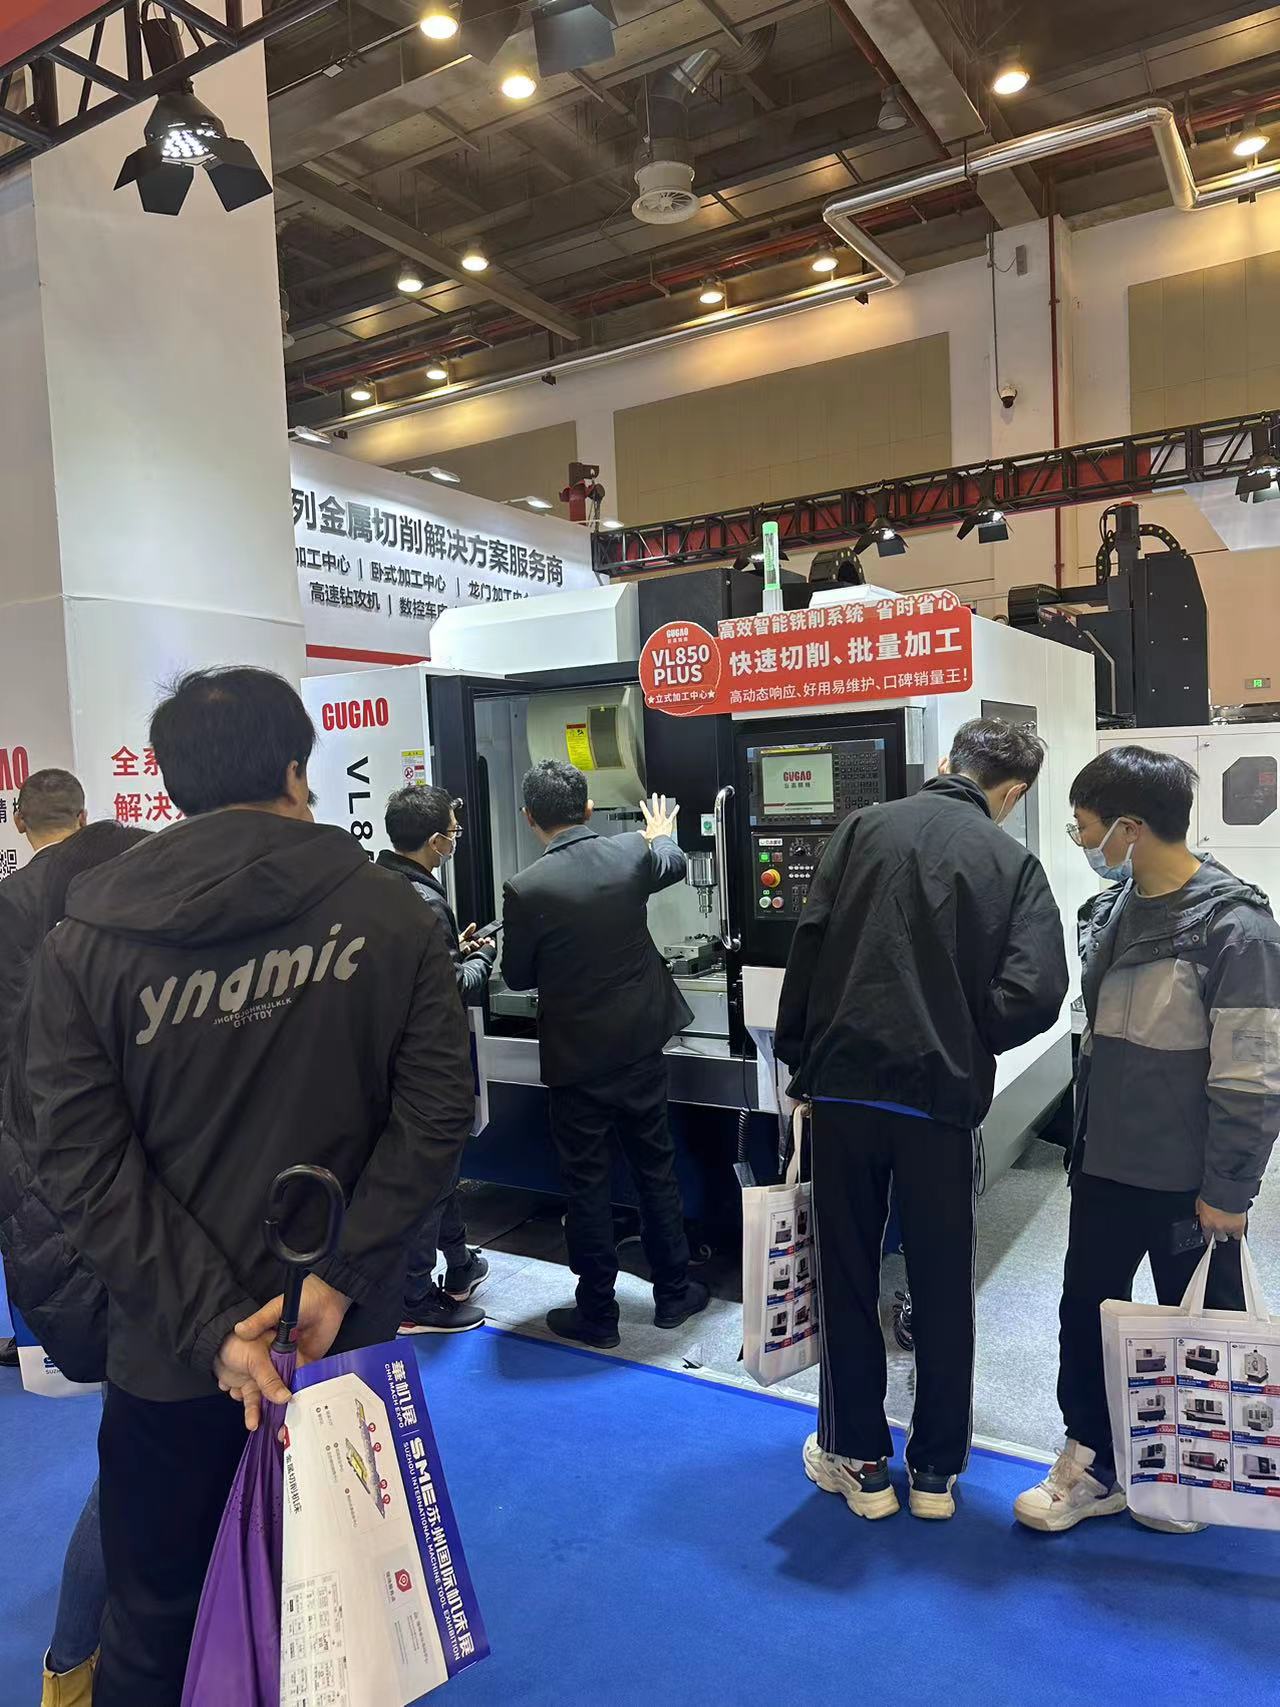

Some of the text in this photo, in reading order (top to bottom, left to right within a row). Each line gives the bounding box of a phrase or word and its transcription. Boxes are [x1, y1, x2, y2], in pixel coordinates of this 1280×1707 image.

[291, 488, 564, 587] 列金属切削解决方案服务商
[309, 581, 381, 611] 高速钻攻机
[370, 561, 446, 592] 卧式加工中心
[468, 580, 529, 602] 龙门加工中
[719, 591, 958, 640] 高效智能铣削系统 省时省心
[651, 644, 711, 667] VL850
[729, 627, 963, 676] 快速切削、批量加工
[653, 664, 703, 686] PLUS
[322, 698, 389, 731] GUGAO
[655, 690, 708, 704] 立式加工中心
[783, 770, 812, 782] GUGAO
[136, 923, 366, 1045] ynamic
[384, 1363, 405, 1429] CHN MACH EXPO
[403, 1441, 461, 1661] SUZHOU INTERNATIONAL MACHINE TOOL EXHIBITION
